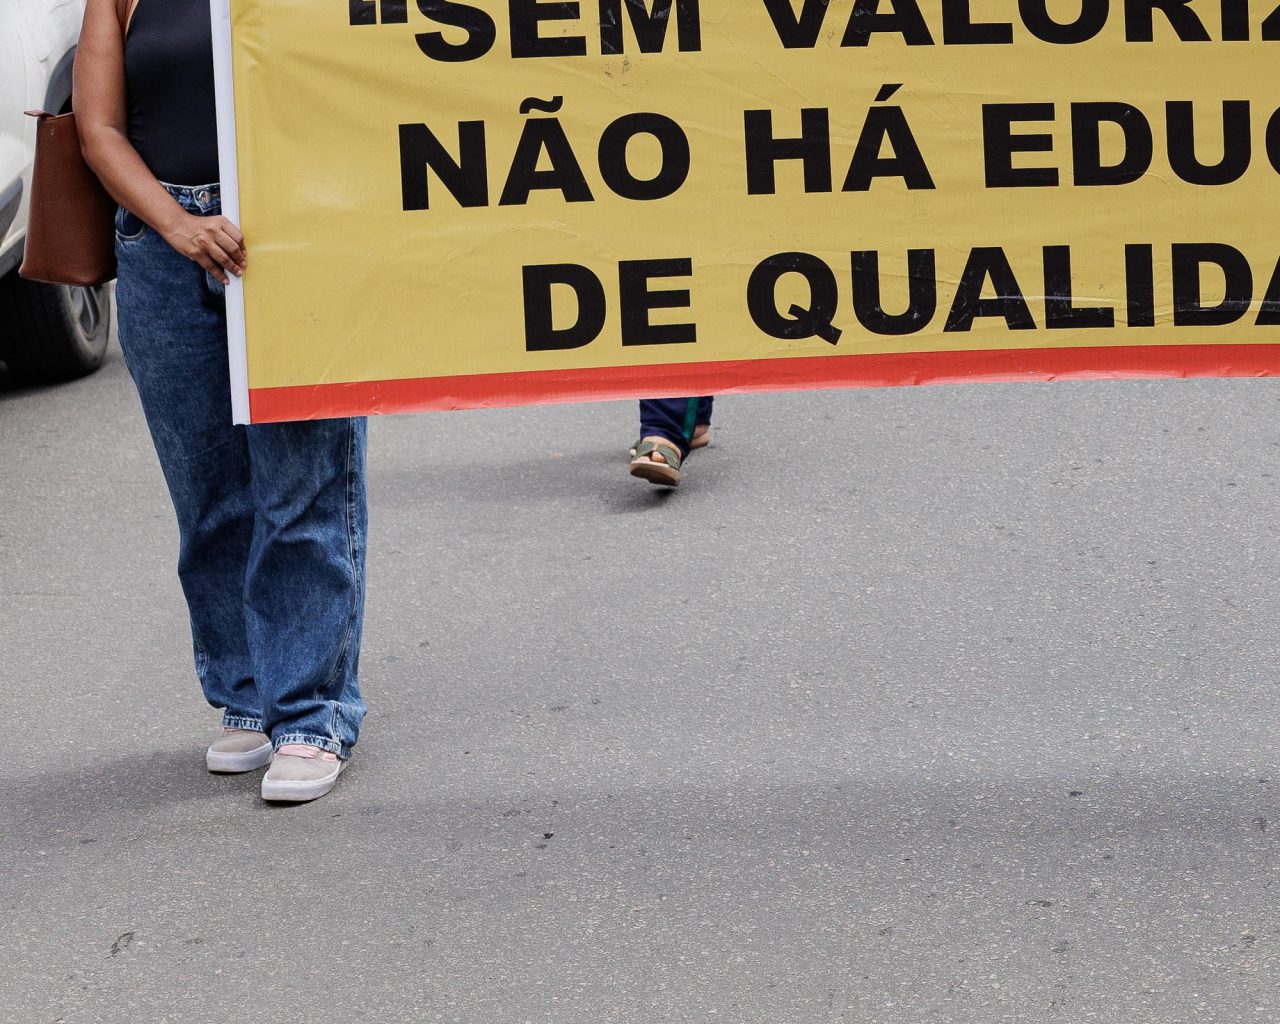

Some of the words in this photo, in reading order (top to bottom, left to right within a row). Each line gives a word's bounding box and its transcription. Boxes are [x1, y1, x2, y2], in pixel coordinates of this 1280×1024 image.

[398, 95, 690, 211] NÃO
[743, 83, 936, 196] HÁ
[521, 257, 697, 352] DE
